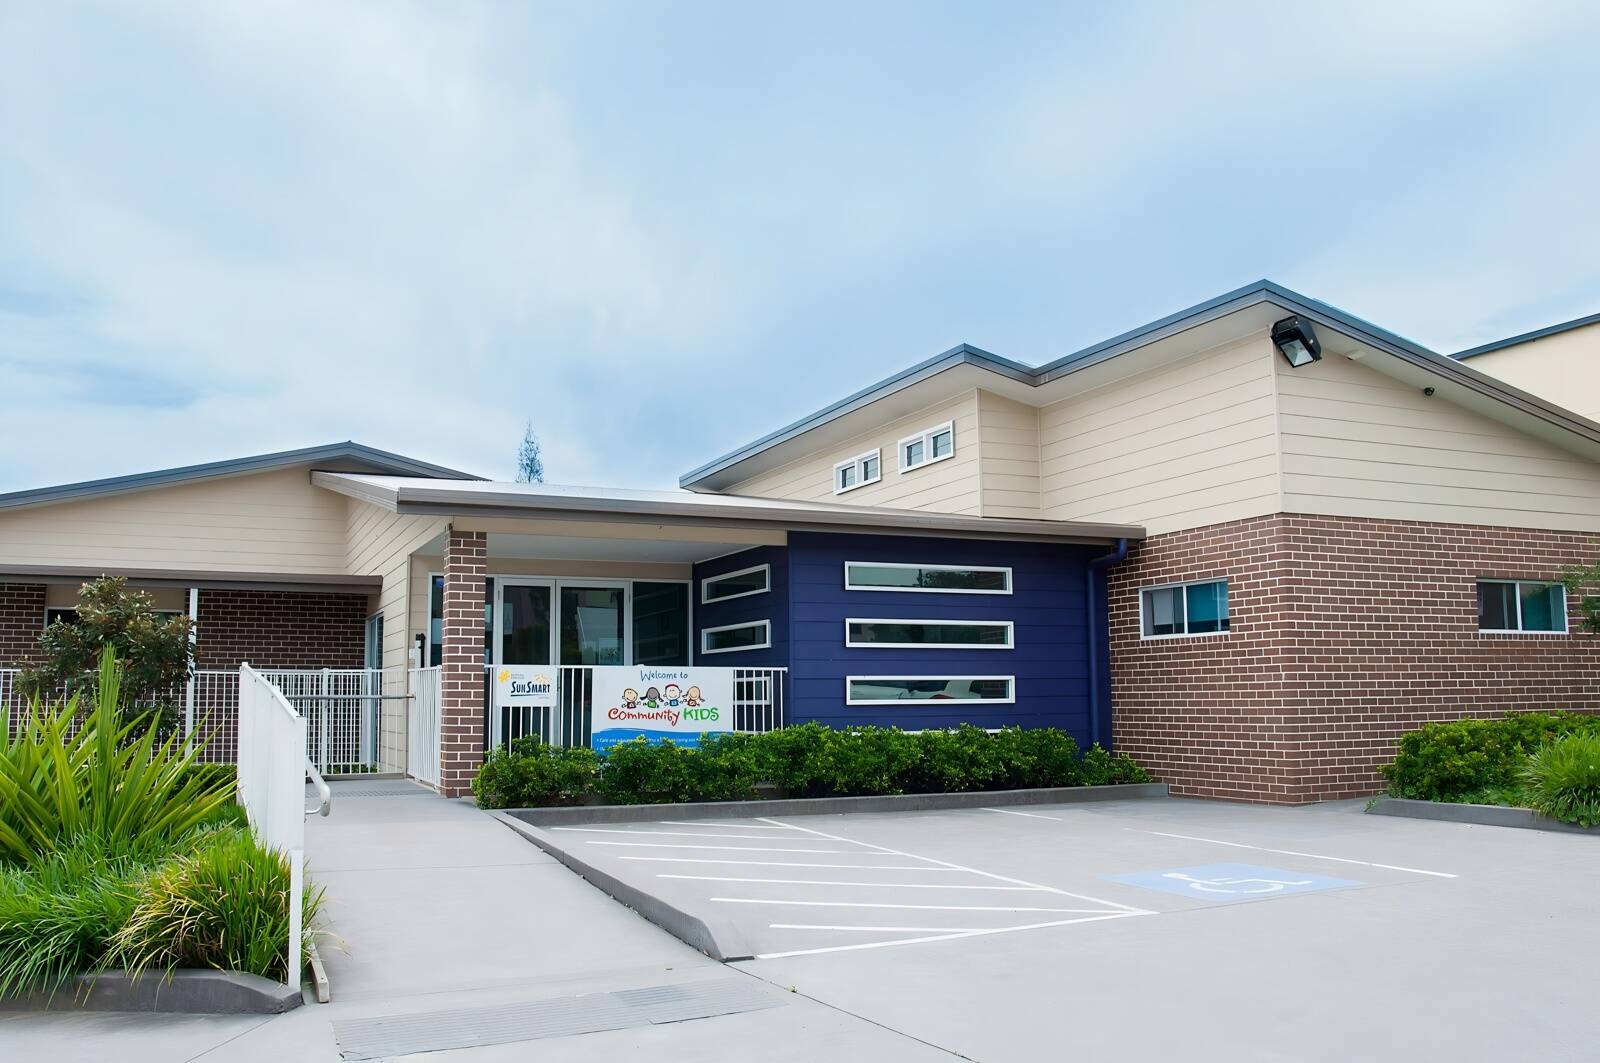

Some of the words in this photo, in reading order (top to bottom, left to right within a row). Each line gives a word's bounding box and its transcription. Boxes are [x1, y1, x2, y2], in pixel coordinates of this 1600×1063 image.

[640, 669, 677, 681] Welcome
[680, 671, 689, 680] to
[608, 707, 680, 727] Community
[683, 707, 720, 721] KIDS
